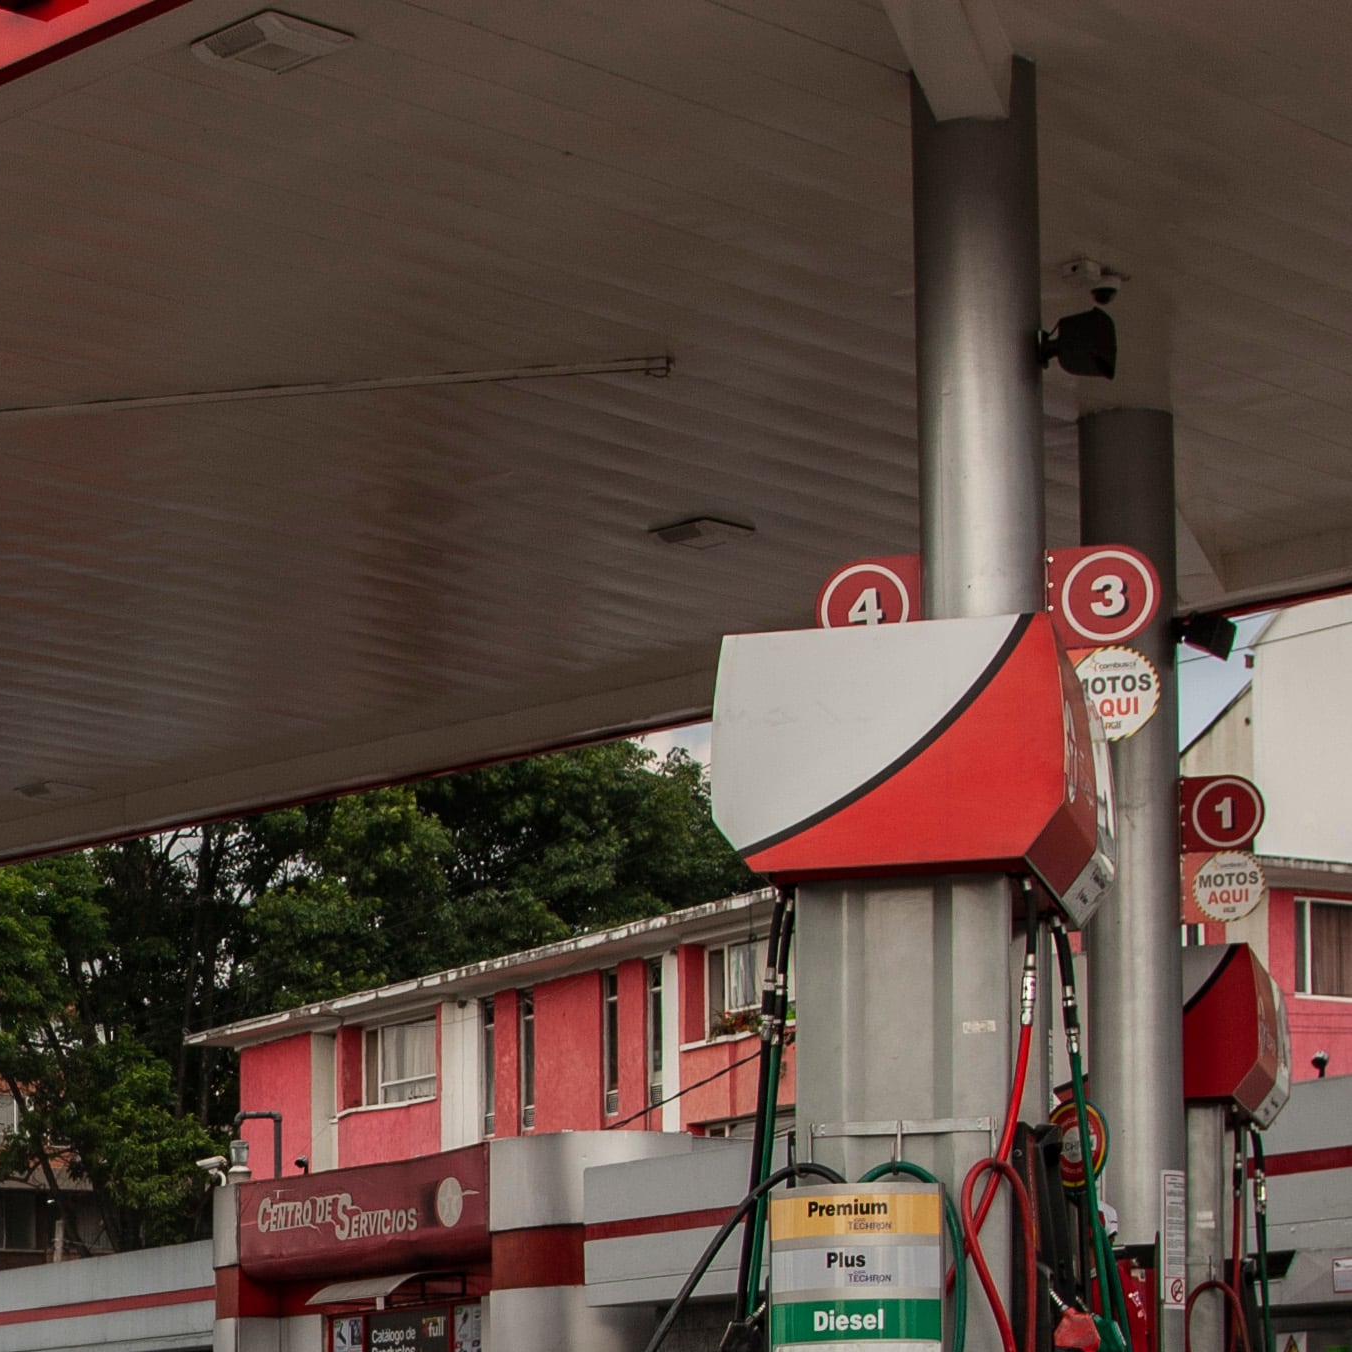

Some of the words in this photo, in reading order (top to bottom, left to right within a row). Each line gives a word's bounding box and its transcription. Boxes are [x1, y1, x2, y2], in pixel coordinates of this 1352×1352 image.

[1090, 574, 1127, 617] 3
[848, 587, 884, 624] 4
[1214, 796, 1234, 829] 1
[1198, 871, 1259, 889] MOTOS
[1207, 888, 1249, 905] AQUI
[315, 1197, 333, 1224] DE
[808, 1199, 888, 1218] Premium
[849, 1221, 892, 1231] TECHRON
[827, 1251, 866, 1268] Plus
[849, 1274, 892, 1284] TECHRON
[813, 1308, 885, 1332] Diesel
[371, 1328, 404, 1345] Catálogo
[405, 1326, 417, 1340] de
